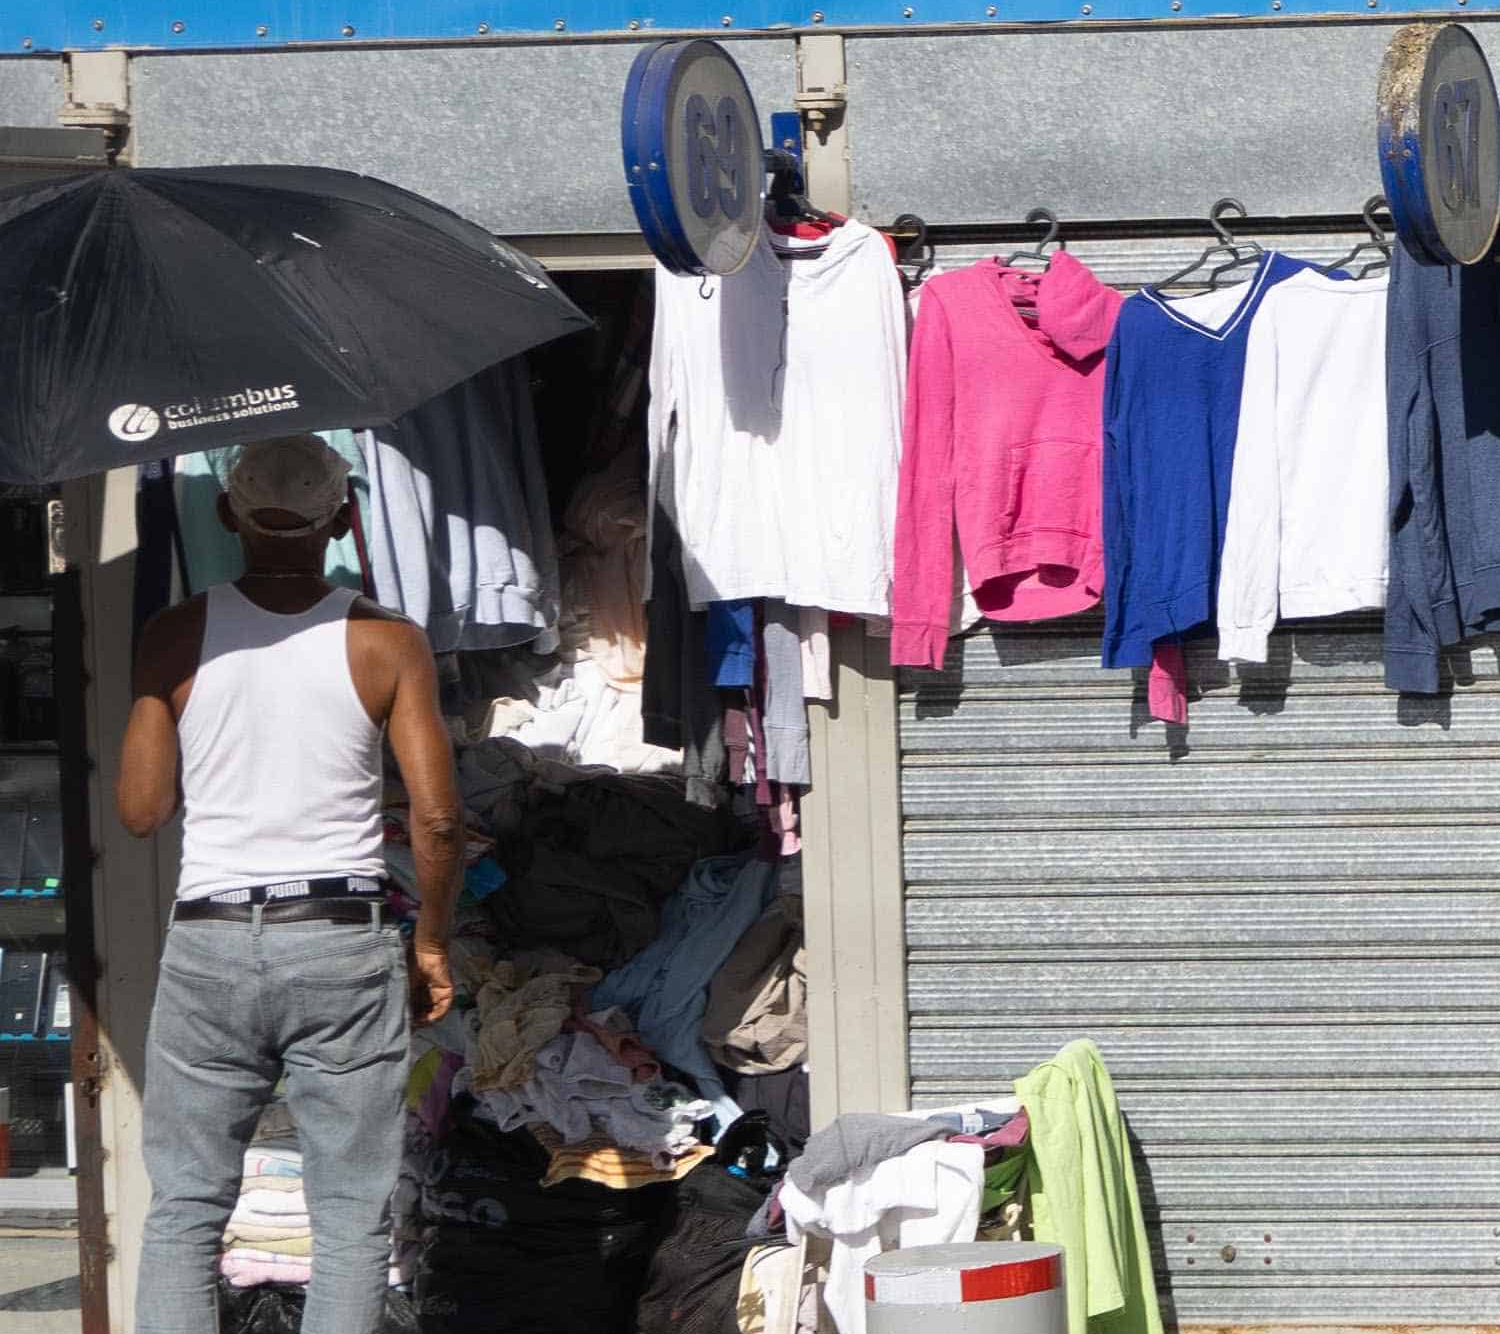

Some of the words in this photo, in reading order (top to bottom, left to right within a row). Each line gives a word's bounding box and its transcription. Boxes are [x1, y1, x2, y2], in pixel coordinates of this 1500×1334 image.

[686, 94, 746, 220] 69
[1433, 78, 1481, 211] 67
[232, 400, 299, 419] solutions
